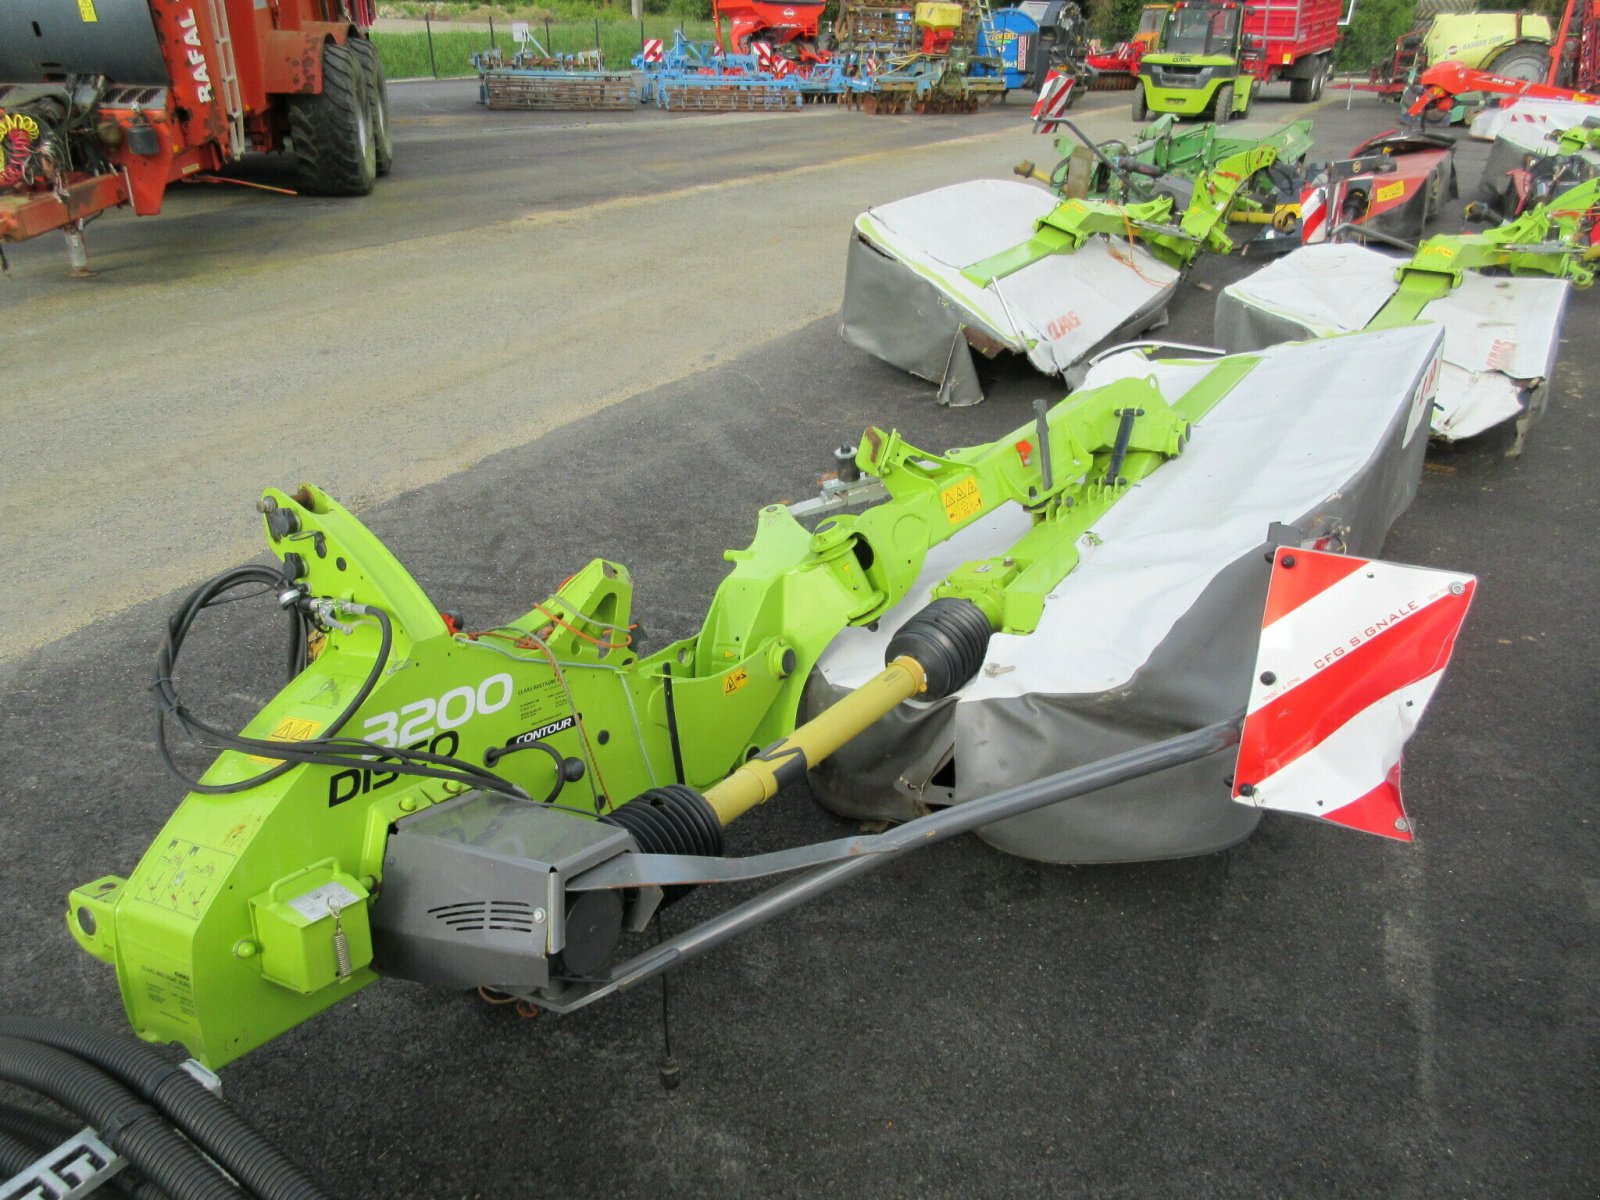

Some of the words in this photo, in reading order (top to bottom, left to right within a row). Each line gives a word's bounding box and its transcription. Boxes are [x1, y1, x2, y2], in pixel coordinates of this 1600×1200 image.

[180, 8, 213, 103] RAFAL
[1313, 646, 1345, 670] CFG
[1349, 600, 1419, 647] SGNALE
[362, 673, 513, 760] 3200
[516, 717, 572, 744] CONTOUR
